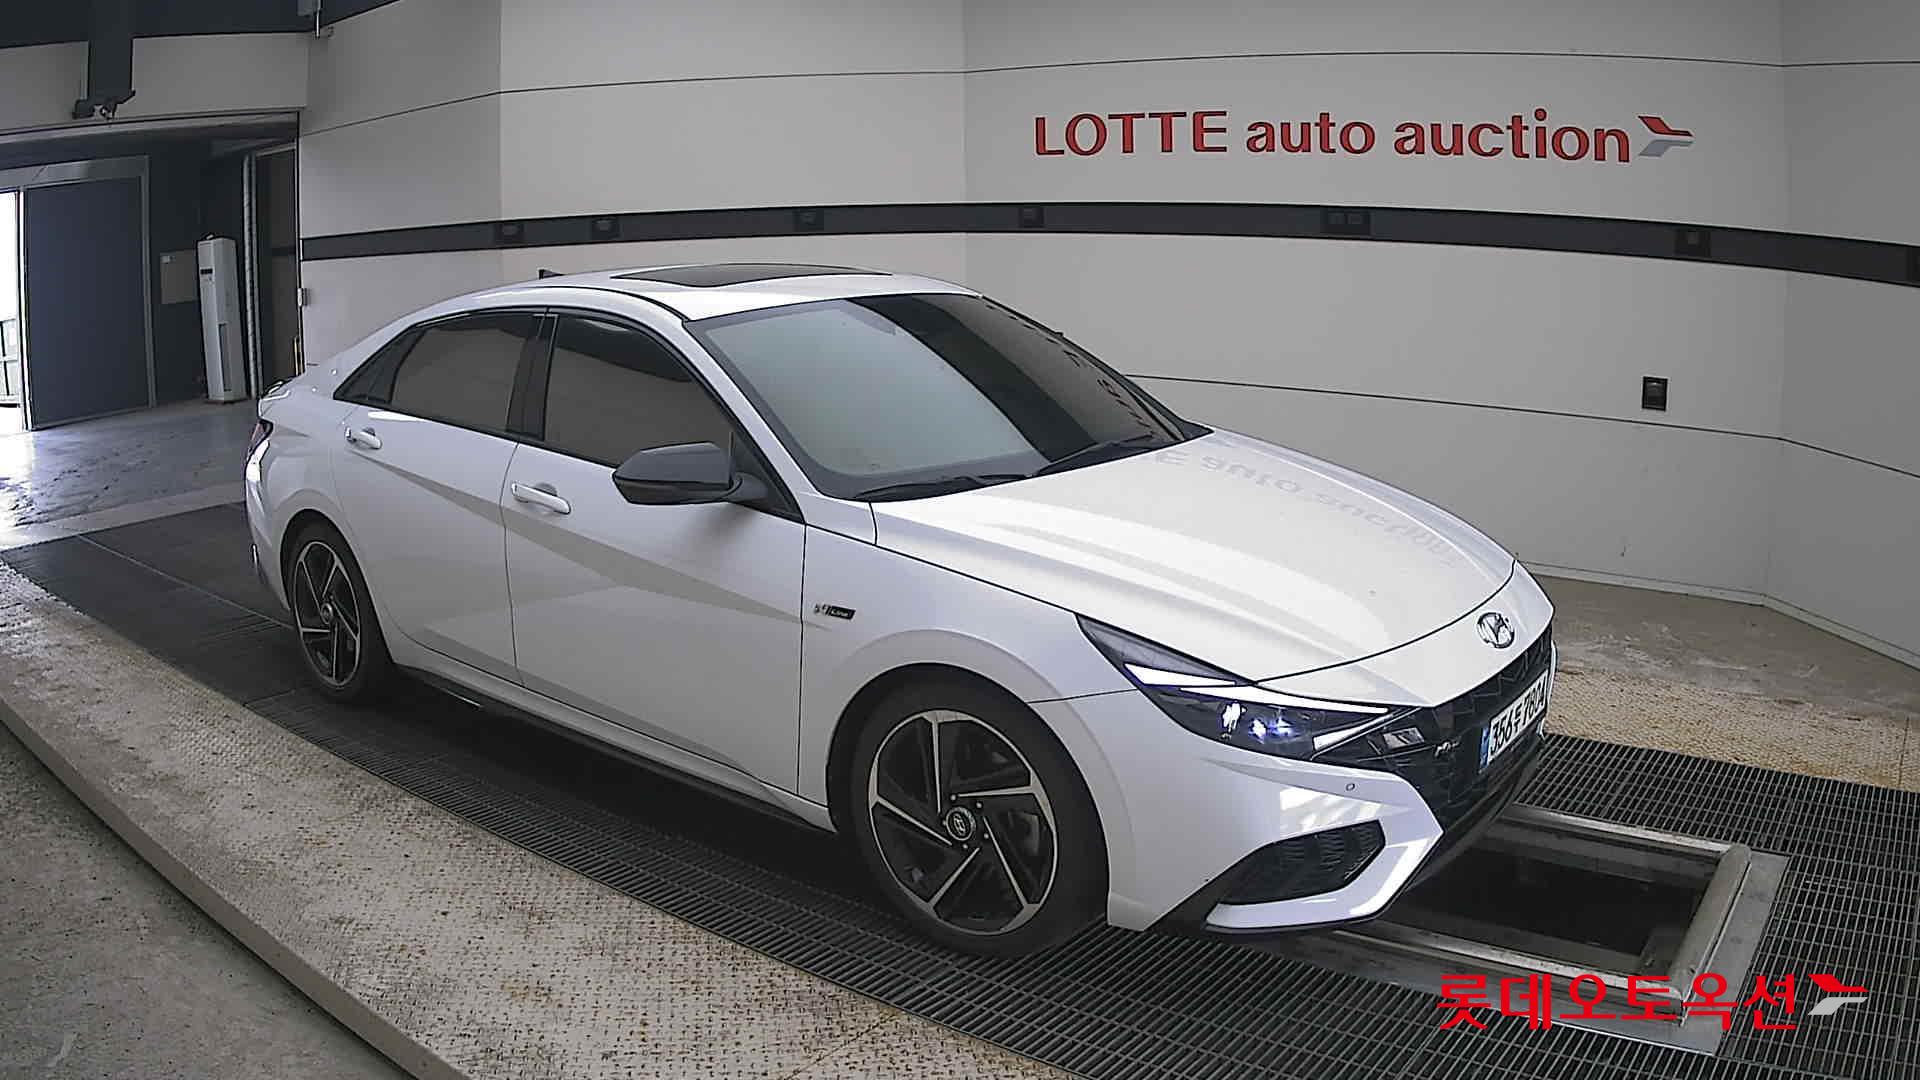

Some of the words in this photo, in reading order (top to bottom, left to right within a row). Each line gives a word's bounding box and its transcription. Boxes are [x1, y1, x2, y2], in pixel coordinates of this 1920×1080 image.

[1034, 111, 1227, 157] LOTTE
[1247, 112, 1376, 157] auto
[1394, 108, 1631, 162] auction
